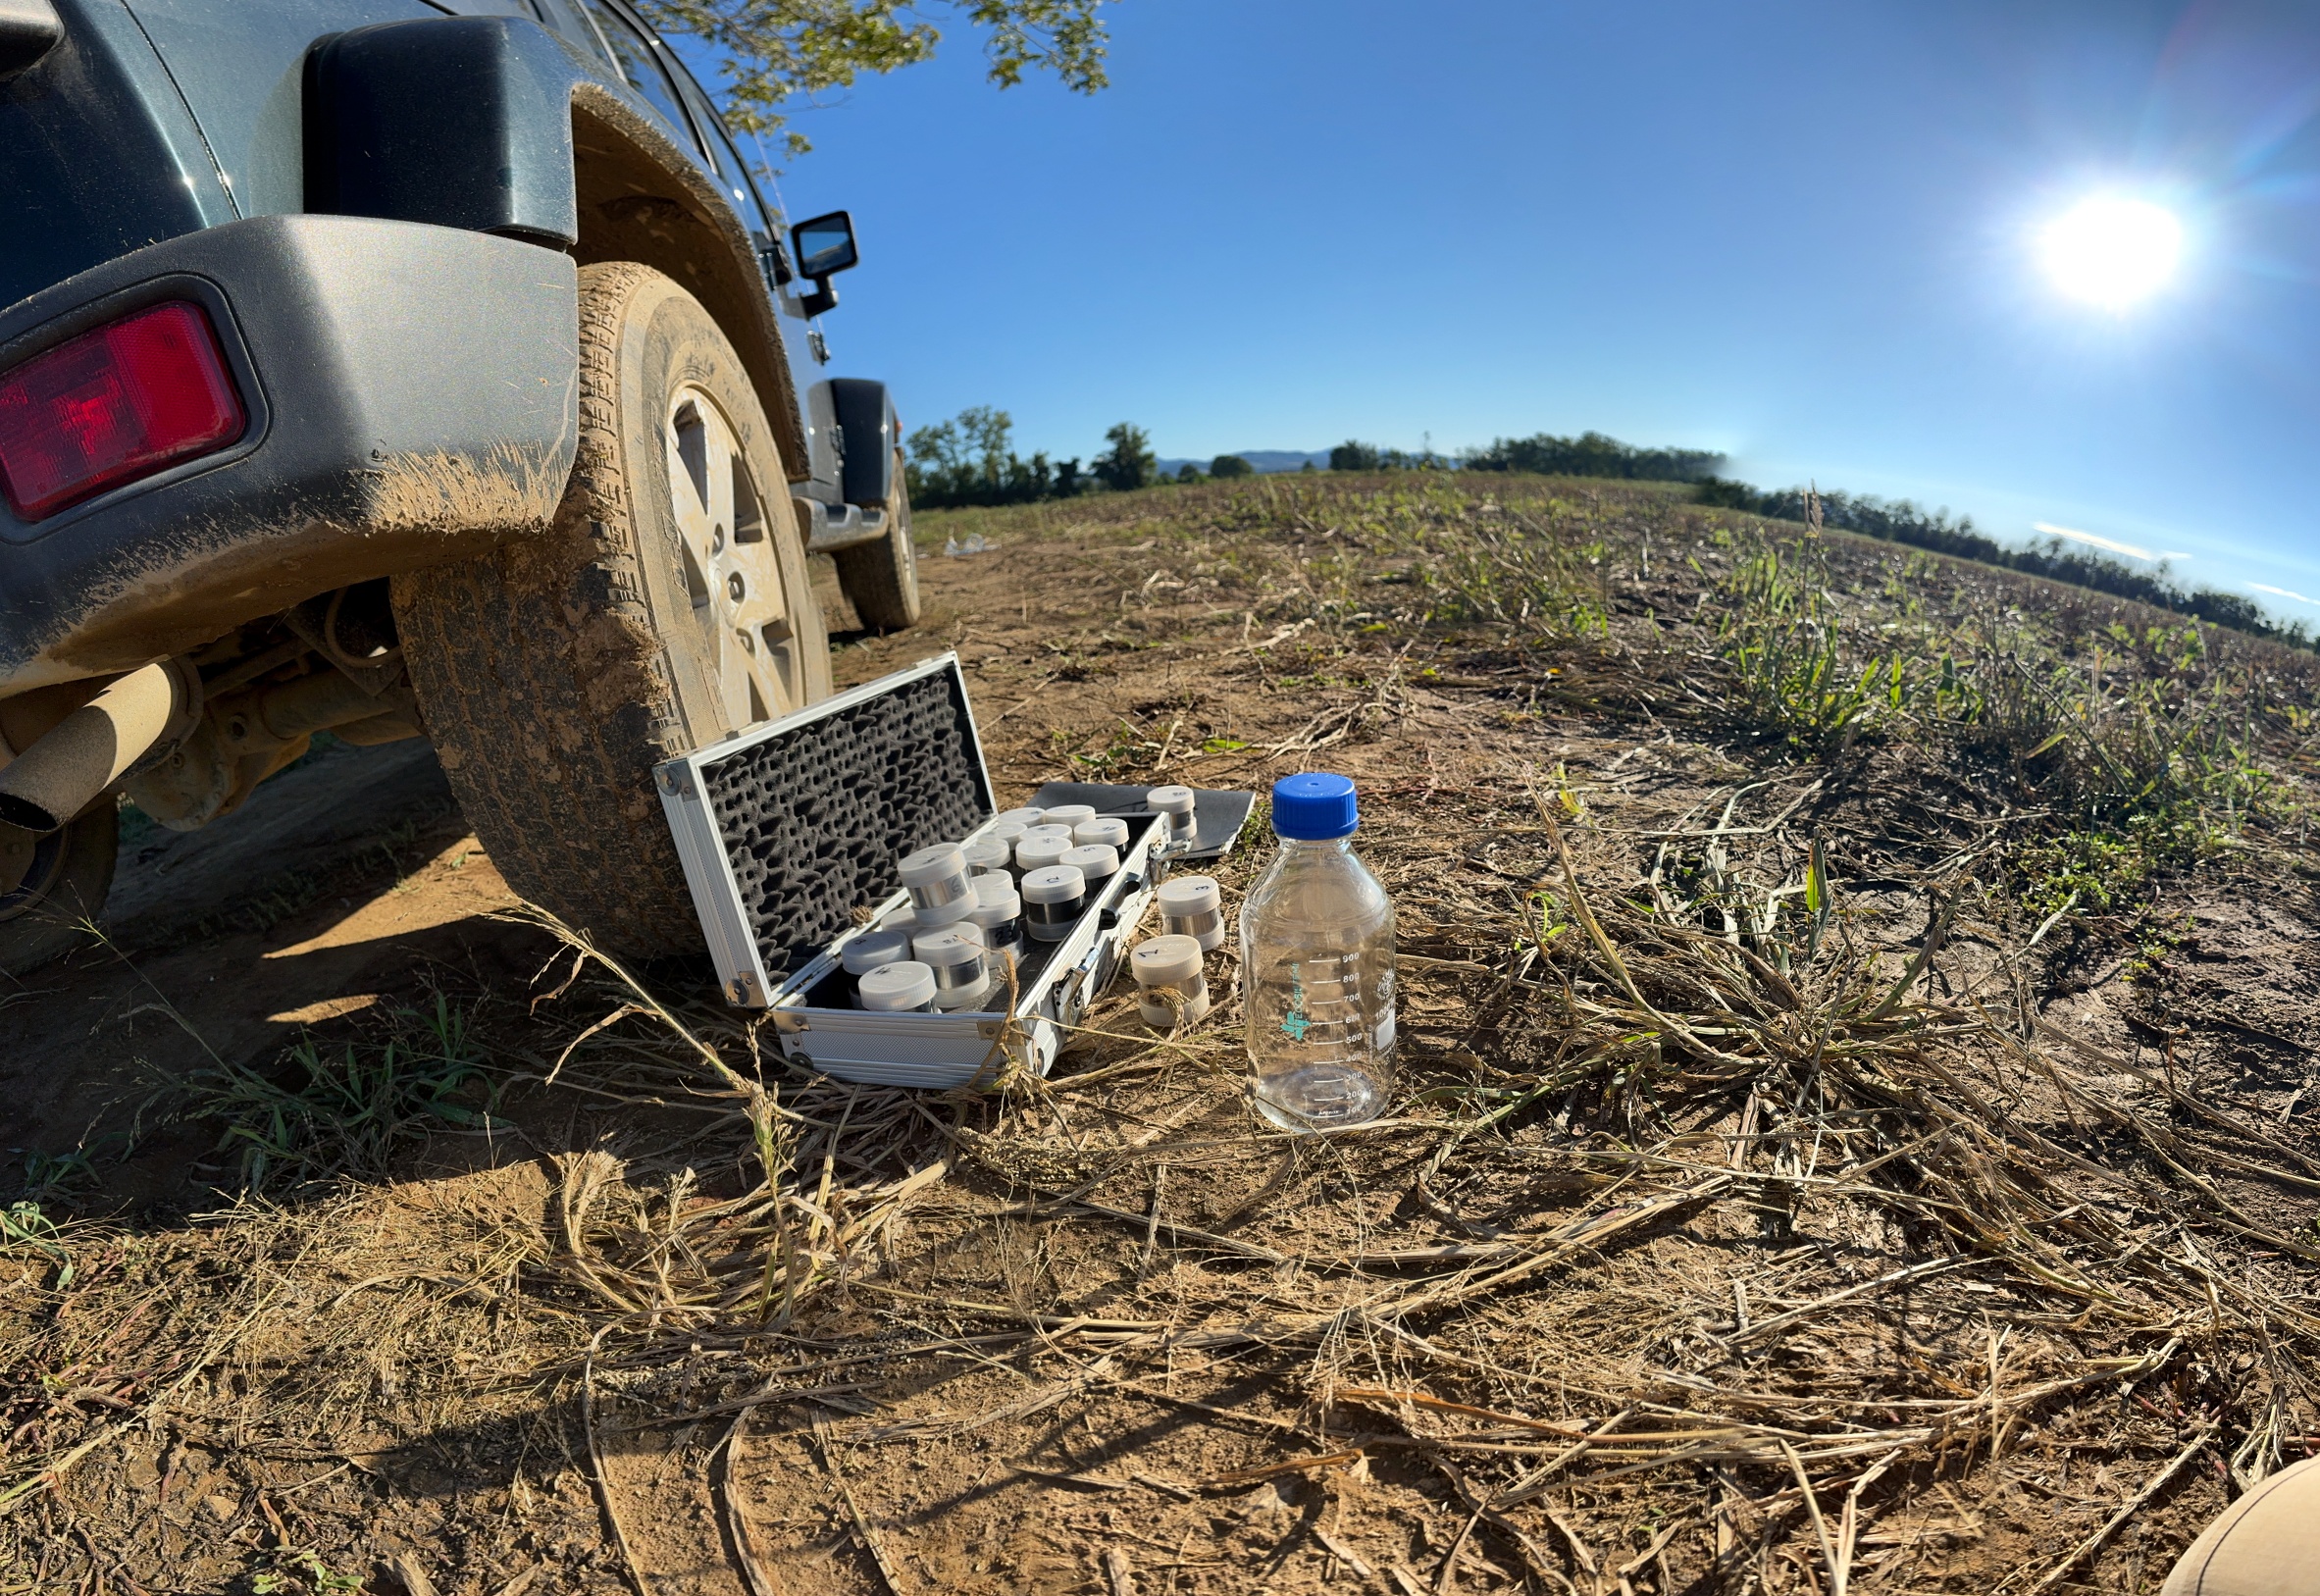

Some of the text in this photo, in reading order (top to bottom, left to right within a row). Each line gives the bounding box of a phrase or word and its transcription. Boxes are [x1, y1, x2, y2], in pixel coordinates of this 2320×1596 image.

[1342, 952, 1360, 963] 900
[1342, 972, 1360, 983] 800
[1343, 993, 1360, 1003] 700
[1345, 1013, 1361, 1024] 600
[1346, 1033, 1363, 1044] 500
[1345, 1053, 1363, 1062] 400
[1346, 1071, 1363, 1081] 300
[1346, 1089, 1363, 1100] 200
[1346, 1106, 1362, 1115] 100
